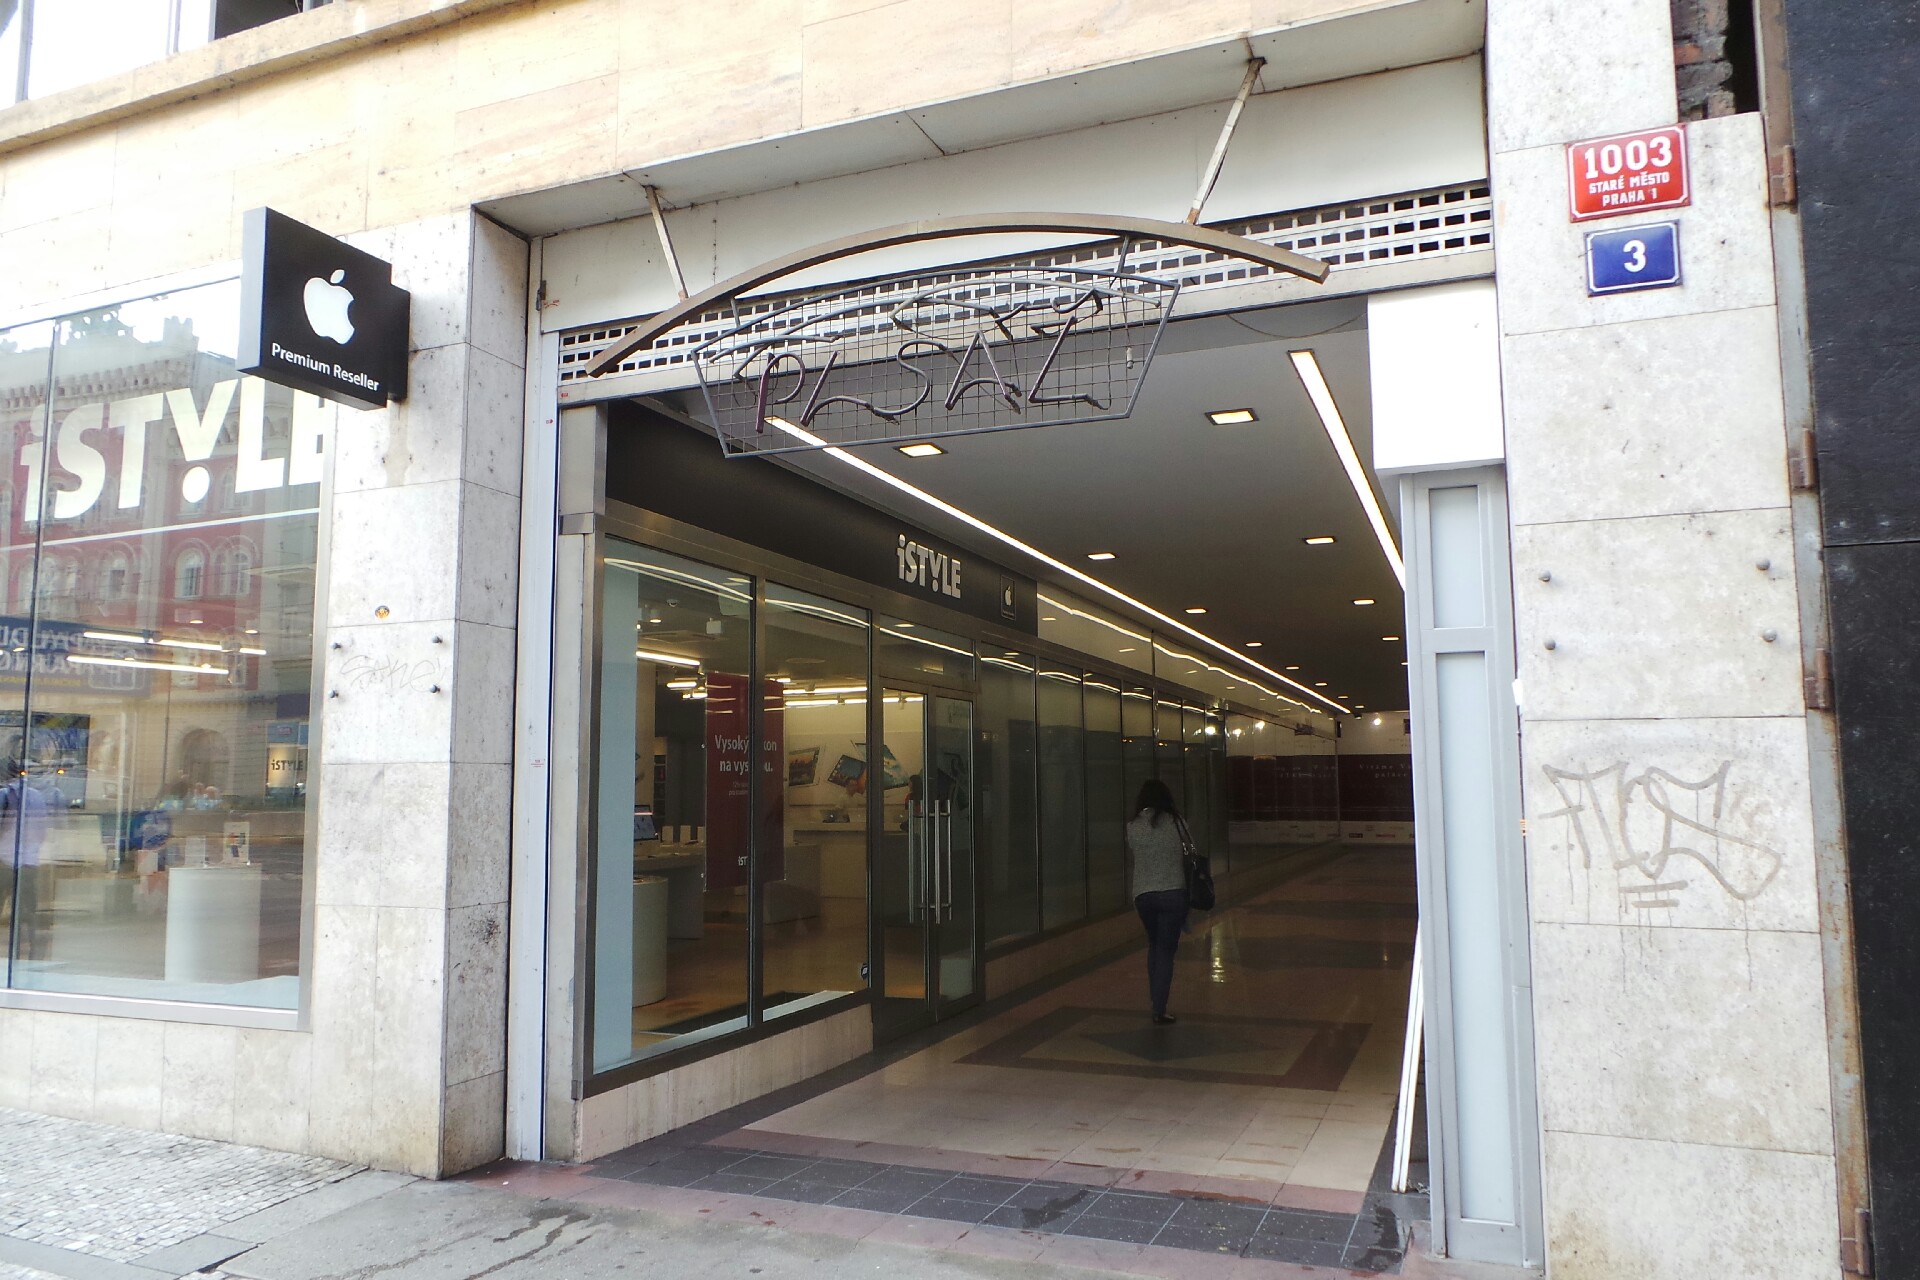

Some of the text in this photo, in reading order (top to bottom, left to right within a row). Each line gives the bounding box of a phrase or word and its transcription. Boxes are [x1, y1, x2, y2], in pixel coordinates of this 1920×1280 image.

[1584, 136, 1673, 179] 1003
[1588, 171, 1671, 194] STARÉ MĚSTO
[1602, 188, 1658, 207] PRAHA 1
[1623, 239, 1646, 272] 3
[272, 342, 379, 390] Premium Reseller
[896, 533, 961, 600] iSTYLE
[714, 734, 749, 754] Vysoký
[719, 760, 731, 772] na
